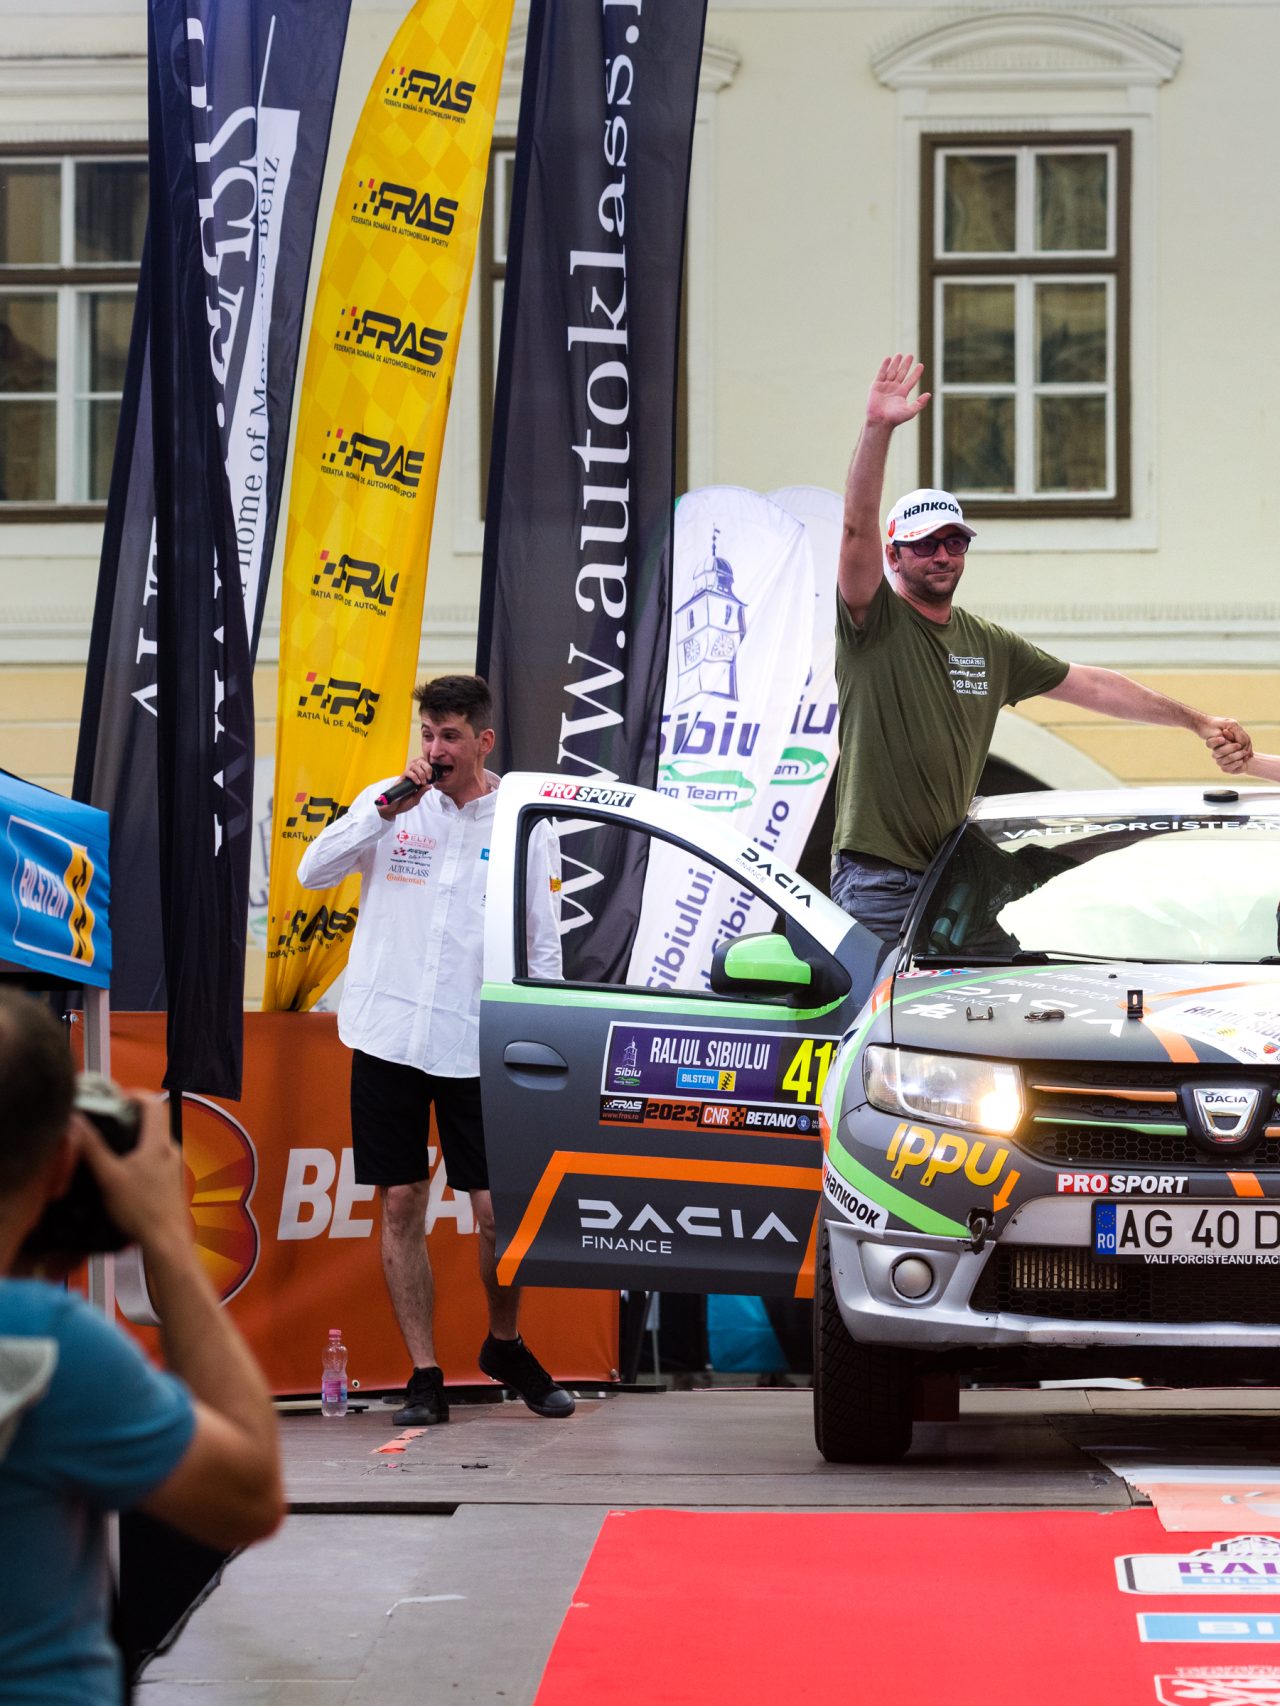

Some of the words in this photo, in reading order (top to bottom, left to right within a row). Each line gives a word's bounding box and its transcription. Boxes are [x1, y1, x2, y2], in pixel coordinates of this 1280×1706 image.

[403, 69, 476, 113] FRAS
[373, 181, 459, 236] FRAS
[356, 309, 448, 366] FRAS
[246, 427, 265, 462] of
[332, 719, 345, 728] DE
[685, 784, 738, 802] Team
[734, 856, 767, 883] FINANCE
[740, 846, 813, 909] DACIA
[946, 986, 1125, 1038] DACIA
[649, 1036, 702, 1066] RALIUL
[705, 1040, 771, 1071] SIBIULUI
[614, 1066, 642, 1077] Sibiu
[681, 1073, 715, 1085] BILSTEIN
[782, 1039, 837, 1105] 41
[612, 1100, 643, 1110] FRAS
[1204, 1093, 1249, 1105] DACIA
[646, 1103, 700, 1122] 2023
[703, 1107, 730, 1125] CNR
[745, 1111, 797, 1128] BETANO
[578, 1199, 799, 1243] DACIA
[1118, 1209, 1173, 1248] AG
[1191, 1209, 1240, 1249] 40
[582, 1235, 673, 1255] FINANCE
[1097, 1233, 1115, 1249] RO
[1144, 1254, 1169, 1265] VALI
[1171, 1254, 1254, 1265] PORCISTEANU
